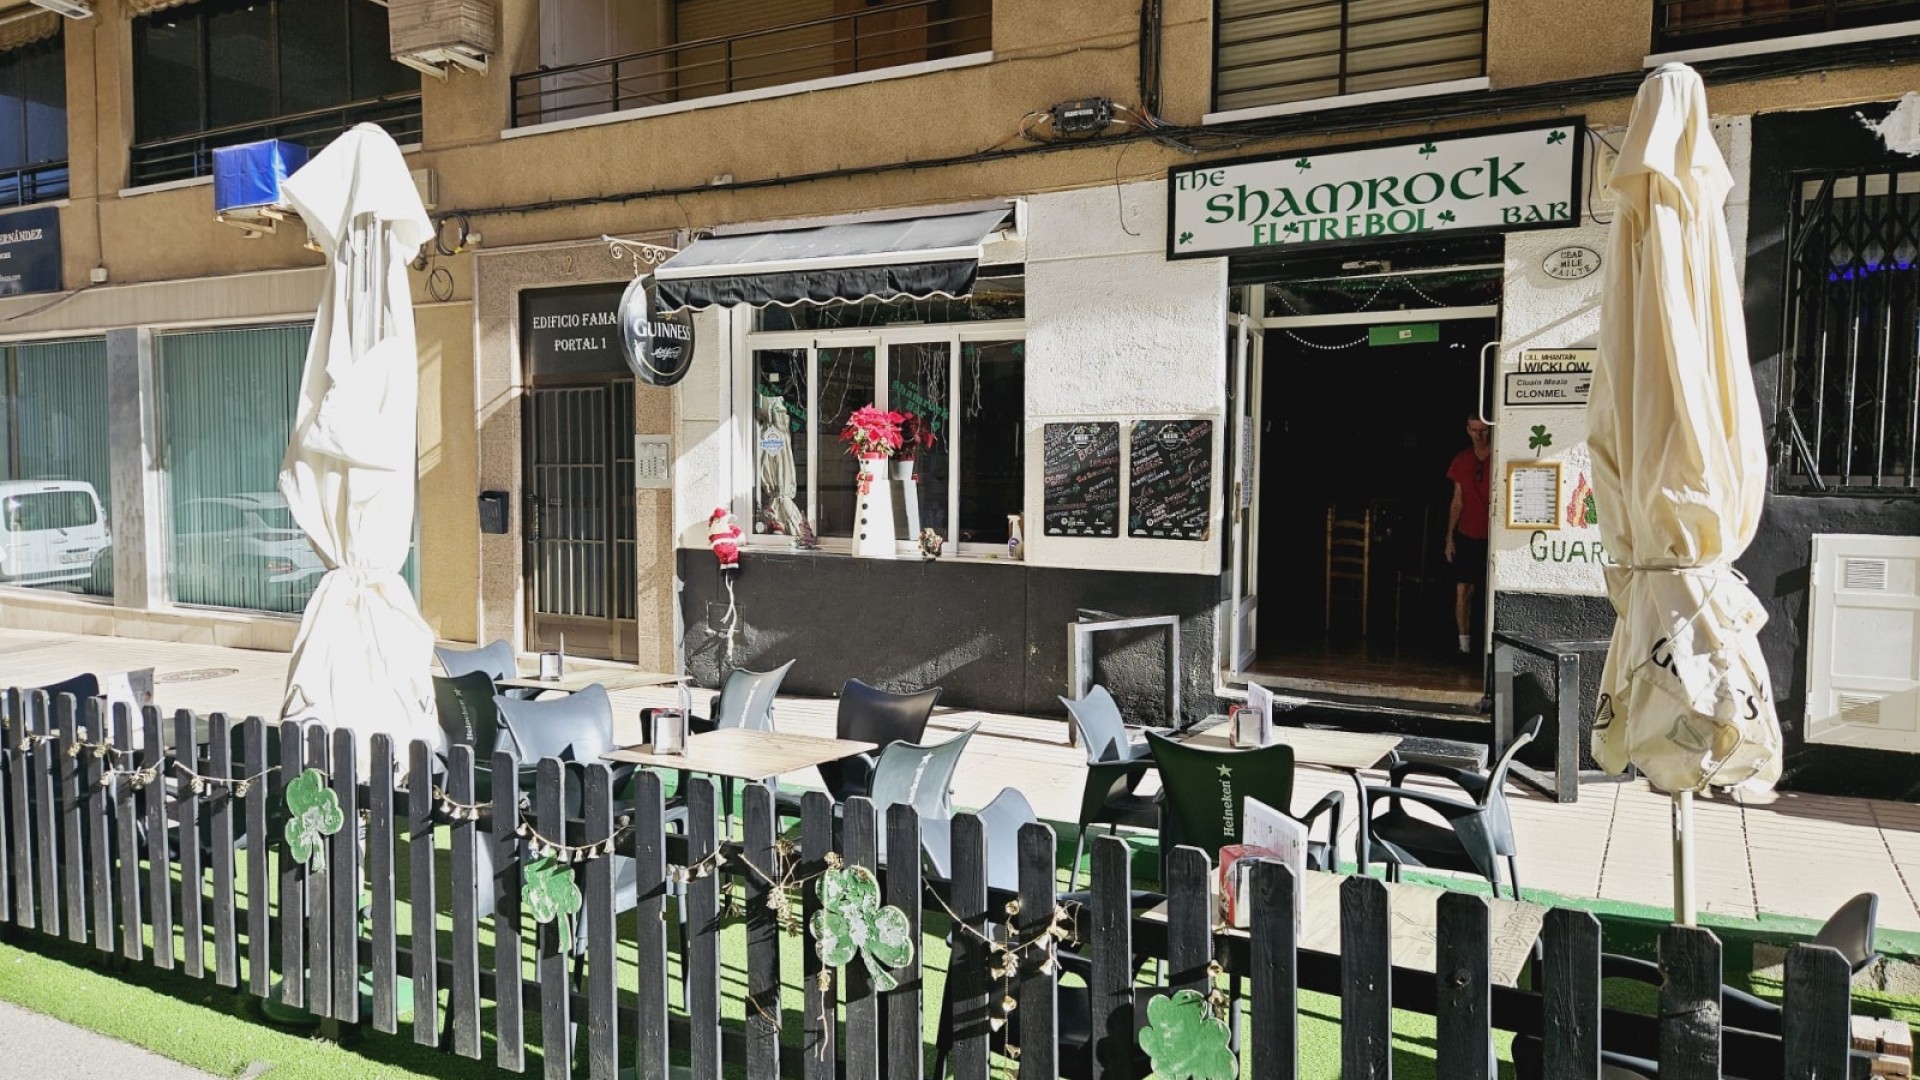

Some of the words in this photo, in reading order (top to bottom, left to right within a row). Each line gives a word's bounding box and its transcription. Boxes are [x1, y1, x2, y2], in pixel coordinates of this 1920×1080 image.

[1501, 201, 1571, 225] BAR
[1253, 223, 1286, 247] EL
[1297, 208, 1434, 242] TREBOL
[1560, 259, 1583, 268] MILE
[533, 315, 579, 330] EDIFICIO
[633, 317, 691, 341] GUINNESS
[554, 337, 598, 351] PORTAL
[601, 337, 607, 349] 1
[1524, 361, 1590, 373] WICKLOW
[1516, 389, 1567, 398] CLONMEL
[1220, 779, 1236, 838] Heineken
